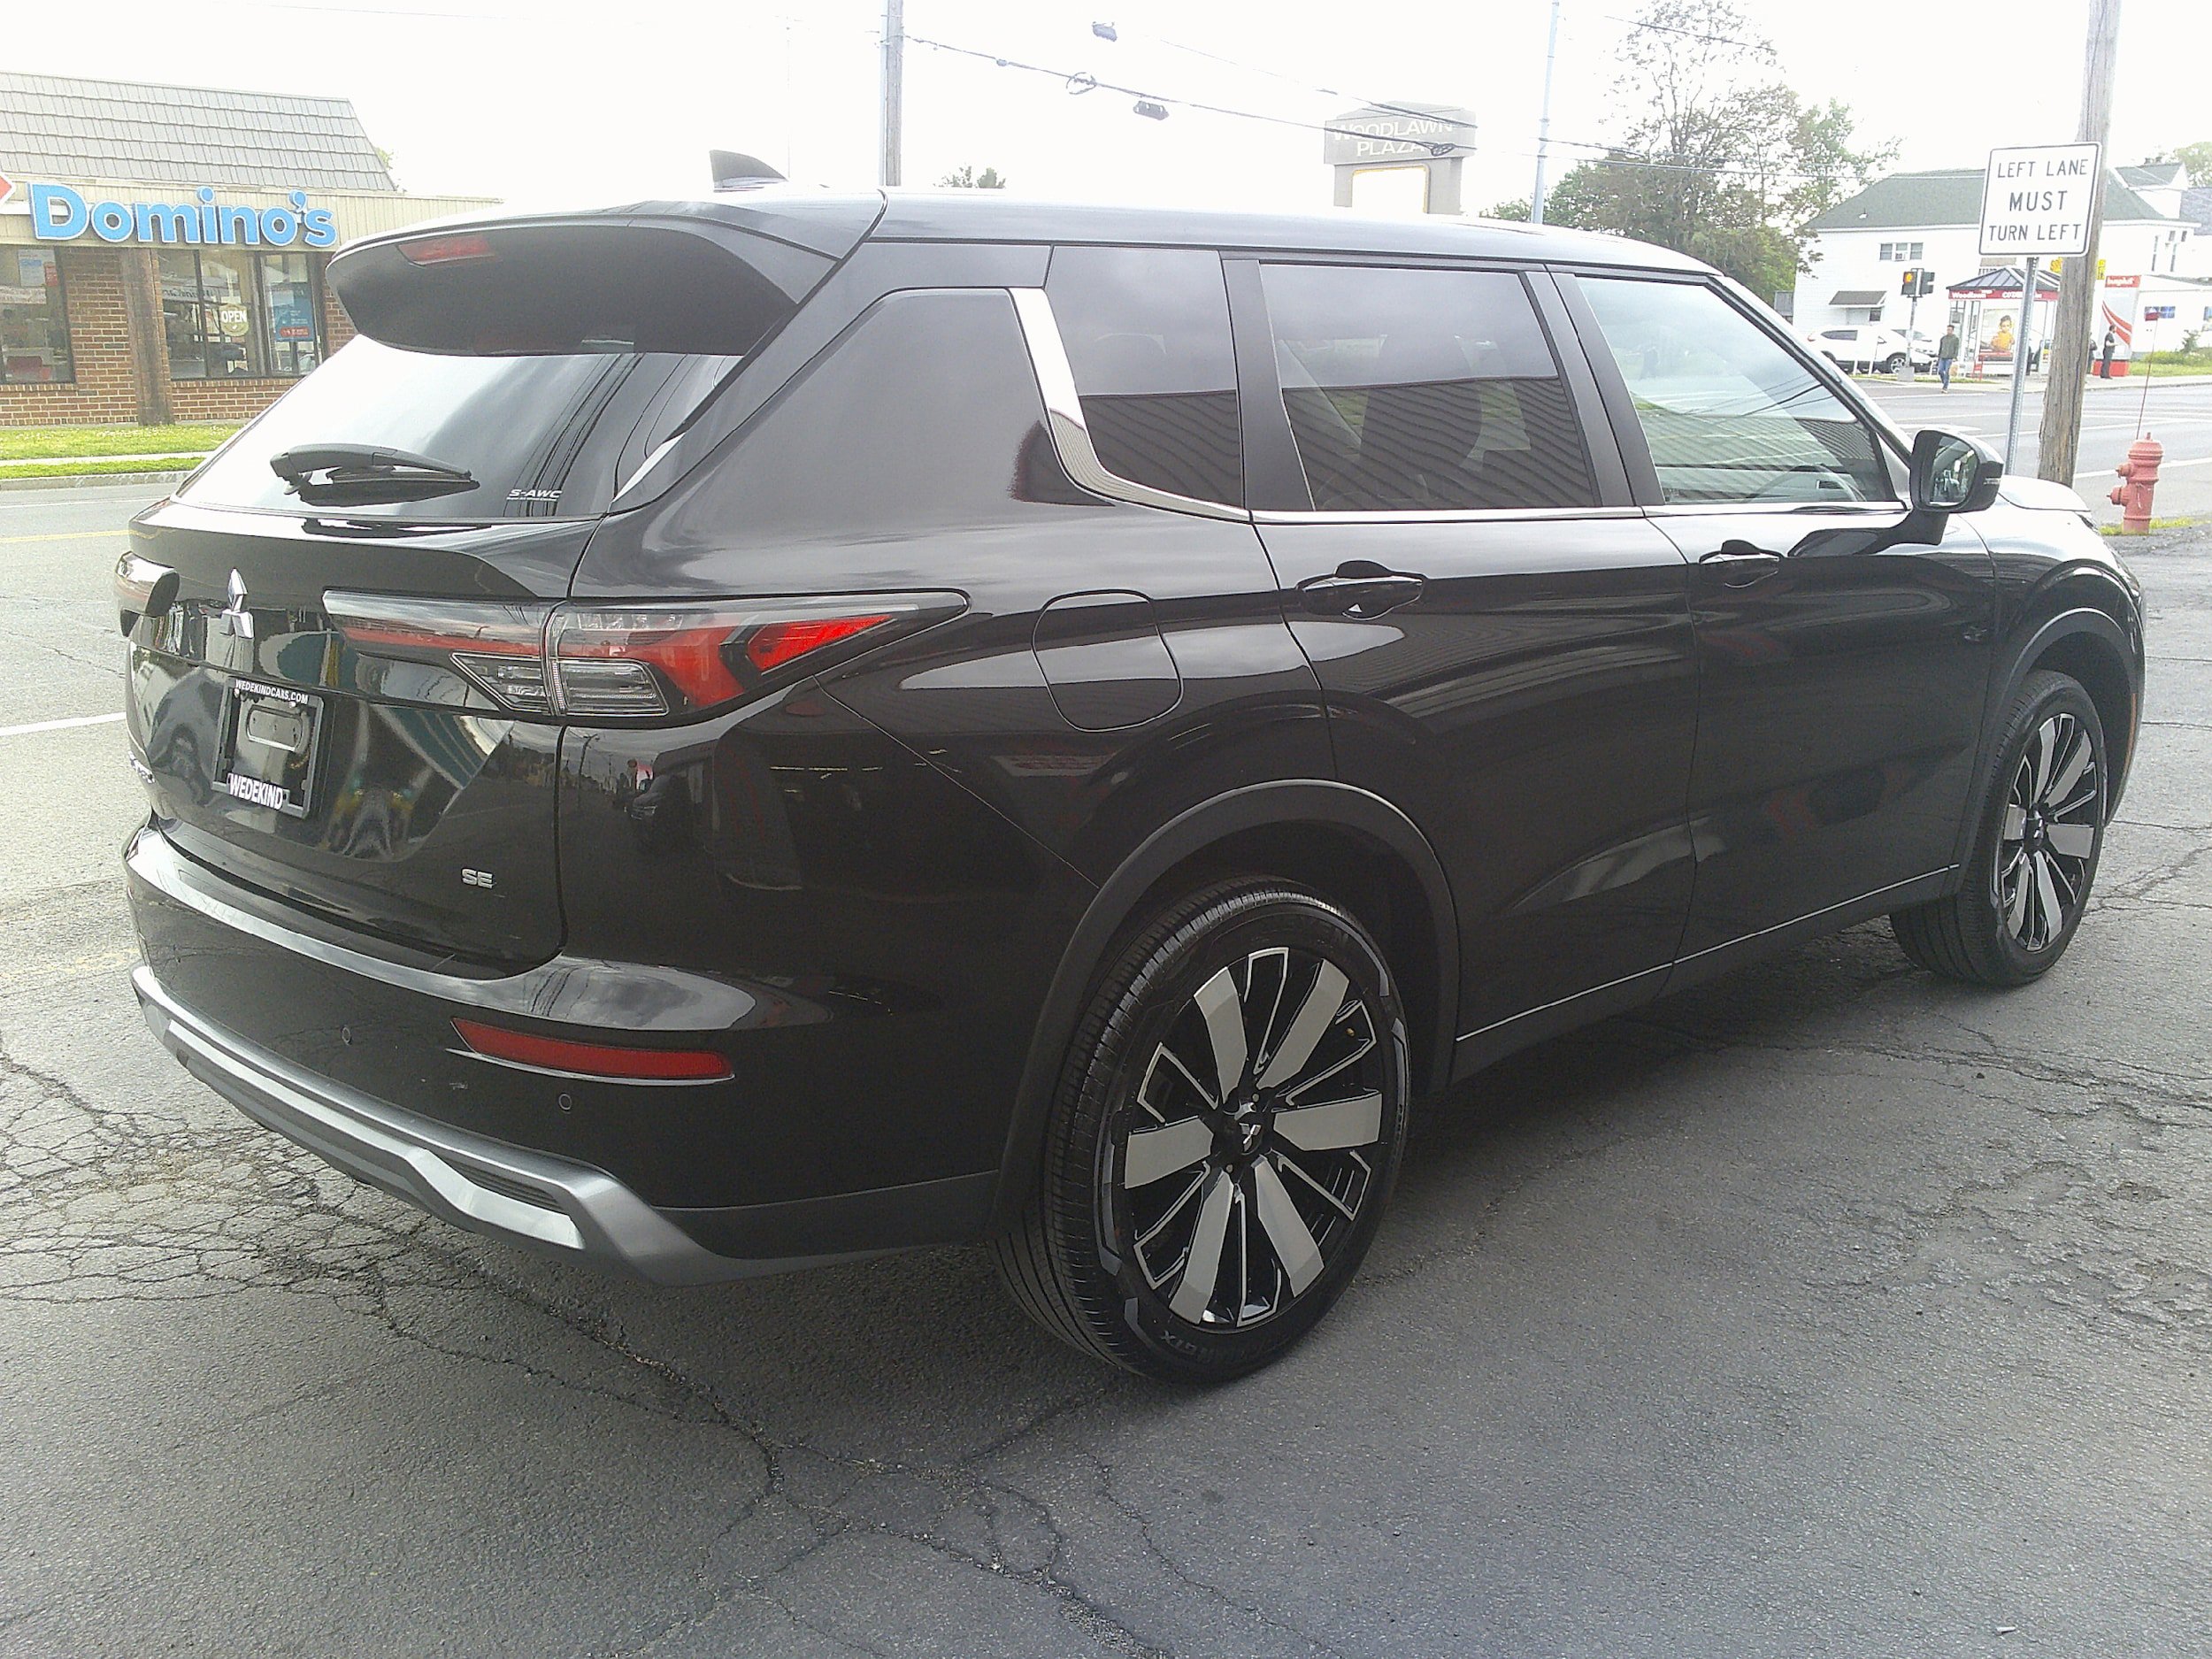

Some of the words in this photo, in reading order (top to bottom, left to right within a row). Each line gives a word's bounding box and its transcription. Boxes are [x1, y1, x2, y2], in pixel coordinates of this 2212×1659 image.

[1356, 140, 1425, 157] PLAZA
[1997, 161, 2037, 179] LEFT
[2046, 158, 2089, 177] LANE
[2008, 190, 2068, 211] MUST
[27, 181, 337, 248] Domino's
[1989, 225, 2029, 242] TURN
[2037, 223, 2082, 241] LEFT
[222, 310, 248, 324] OPEN
[509, 488, 563, 497] S-AWC
[229, 773, 283, 810] WEDEKIND
[462, 868, 493, 889] SE
